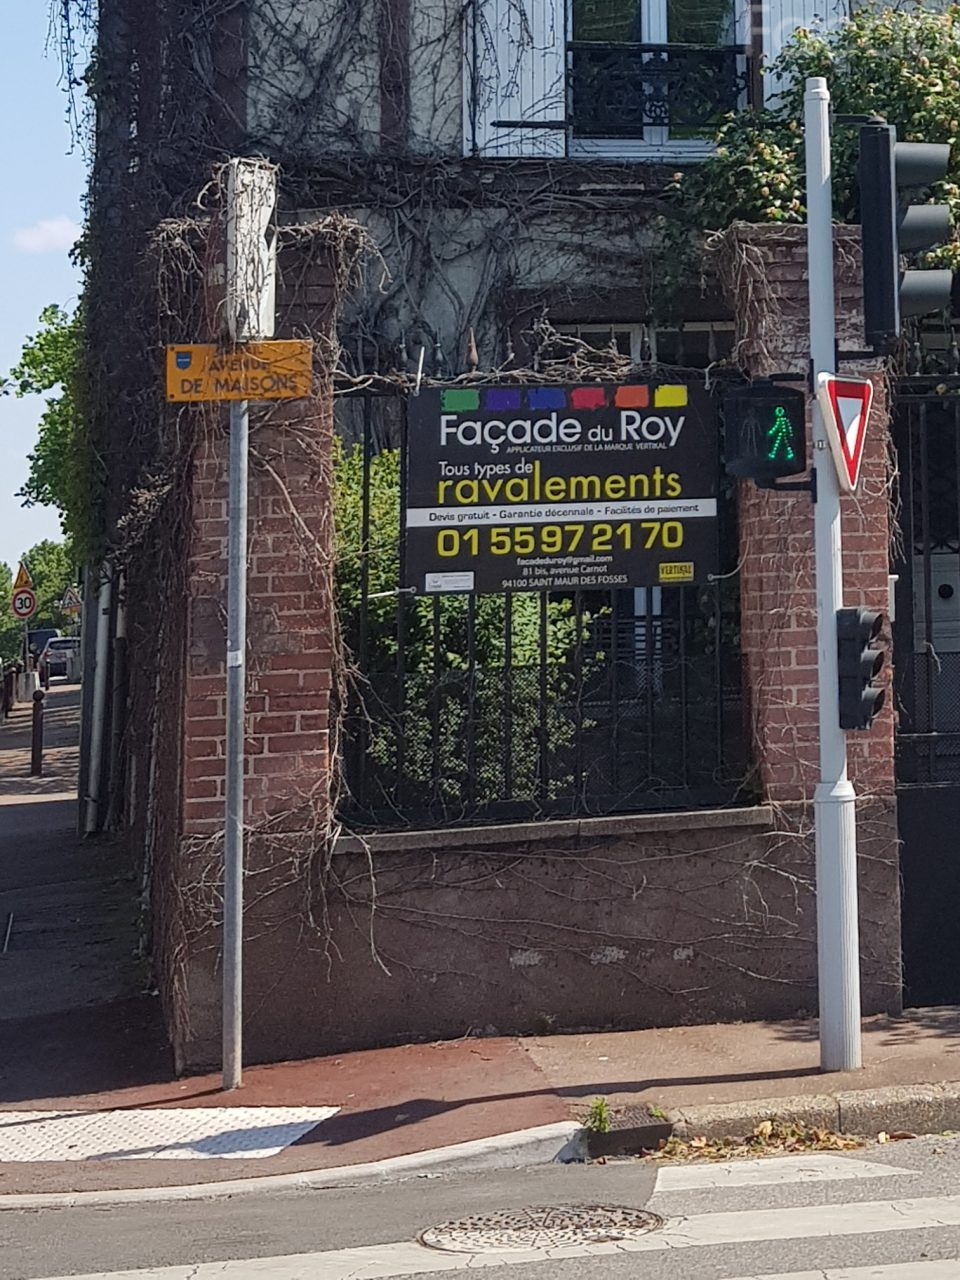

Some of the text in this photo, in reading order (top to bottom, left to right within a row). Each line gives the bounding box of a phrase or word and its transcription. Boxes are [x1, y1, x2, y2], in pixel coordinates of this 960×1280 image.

[181, 375, 297, 394] DE MAISONS
[440, 410, 685, 454] Façade du Roy
[506, 445, 550, 454] APPLICATEUR
[552, 444, 582, 453] EXCLUSIF
[584, 444, 593, 452] DE
[594, 443, 604, 451] LA
[604, 443, 633, 451] MARQUE
[438, 457, 533, 479] Tous types de
[438, 460, 682, 505] ravalements
[429, 511, 455, 522] Devis
[457, 511, 490, 523] gratuit
[499, 509, 543, 519] Garantie
[545, 507, 594, 518] décennale
[604, 506, 642, 515] Facilités
[644, 505, 655, 514] de
[657, 504, 699, 515] paiement
[437, 521, 683, 557] 01 55 97 21 70
[550, 567, 579, 575] avenue
[580, 565, 608, 574] Carnot
[502, 575, 628, 588] 94100 SAINT MAUR DES FOSSES
[16, 597, 32, 610] 30
